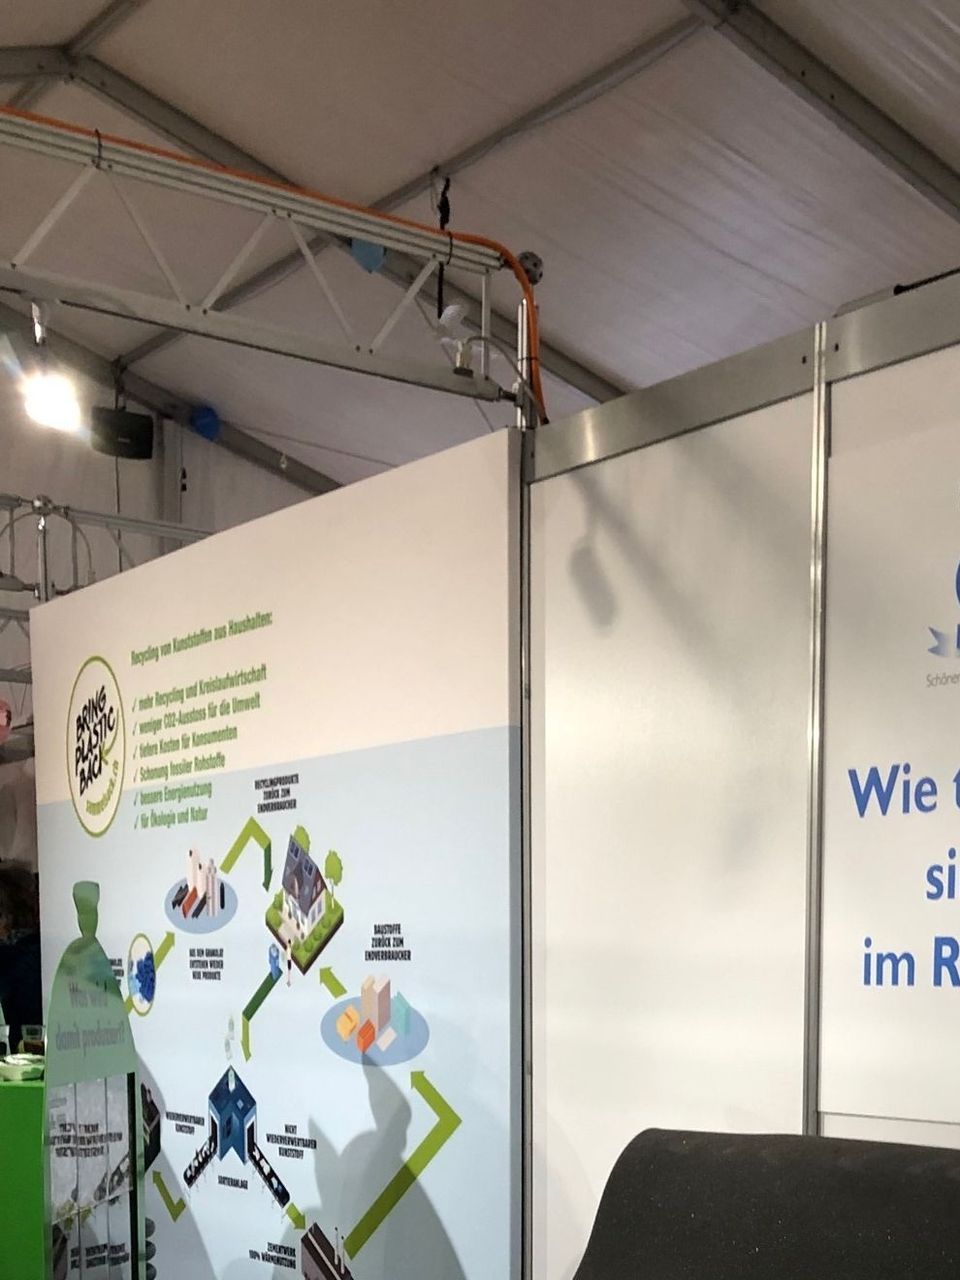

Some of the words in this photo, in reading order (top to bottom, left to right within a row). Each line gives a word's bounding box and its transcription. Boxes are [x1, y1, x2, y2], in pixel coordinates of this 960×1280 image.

[131, 645, 159, 666] Recycling
[160, 642, 171, 656] von
[173, 628, 212, 653] Kunststoffen
[214, 625, 226, 640] aus
[139, 694, 153, 711] mehr
[155, 687, 184, 707] Recycling
[186, 681, 198, 699] und
[199, 663, 266, 695] Kreislaufwirtschaft
[76, 685, 107, 743] BRING
[139, 717, 162, 735] weniger
[208, 701, 217, 719] für
[219, 699, 230, 716] die
[232, 691, 260, 714] Umwelt
[75, 706, 116, 777] PLASTIC
[160, 736, 180, 753] Kosten
[181, 733, 190, 749] für
[192, 725, 237, 747] Konsumenten
[80, 743, 109, 797] BACK
[140, 764, 168, 781] Schonung
[170, 759, 192, 776] fossiler
[194, 751, 225, 772] Rohstoffe
[140, 790, 162, 805] bessere
[164, 781, 212, 803] Energienutzung
[254, 773, 299, 790] RECYCLINGPRODUKTE
[263, 789, 279, 801] ZURÜCK
[281, 787, 290, 799] ZUM
[848, 763, 938, 818] Wie
[141, 813, 149, 829] für
[150, 809, 175, 828] Ökologie
[177, 807, 188, 824] und
[190, 806, 208, 822] Natur
[257, 799, 297, 814] ENDVERBRAUCHER
[371, 935, 391, 948] ZURÜCK
[392, 937, 404, 947] ZUM
[374, 923, 401, 935] BAUSTOFFE
[365, 950, 411, 962] ENDVERBRAUCHER
[863, 936, 915, 987] im
[218, 1175, 248, 1190] SORTIERANLAGE
[267, 1242, 296, 1257] ZEMENTWERK
